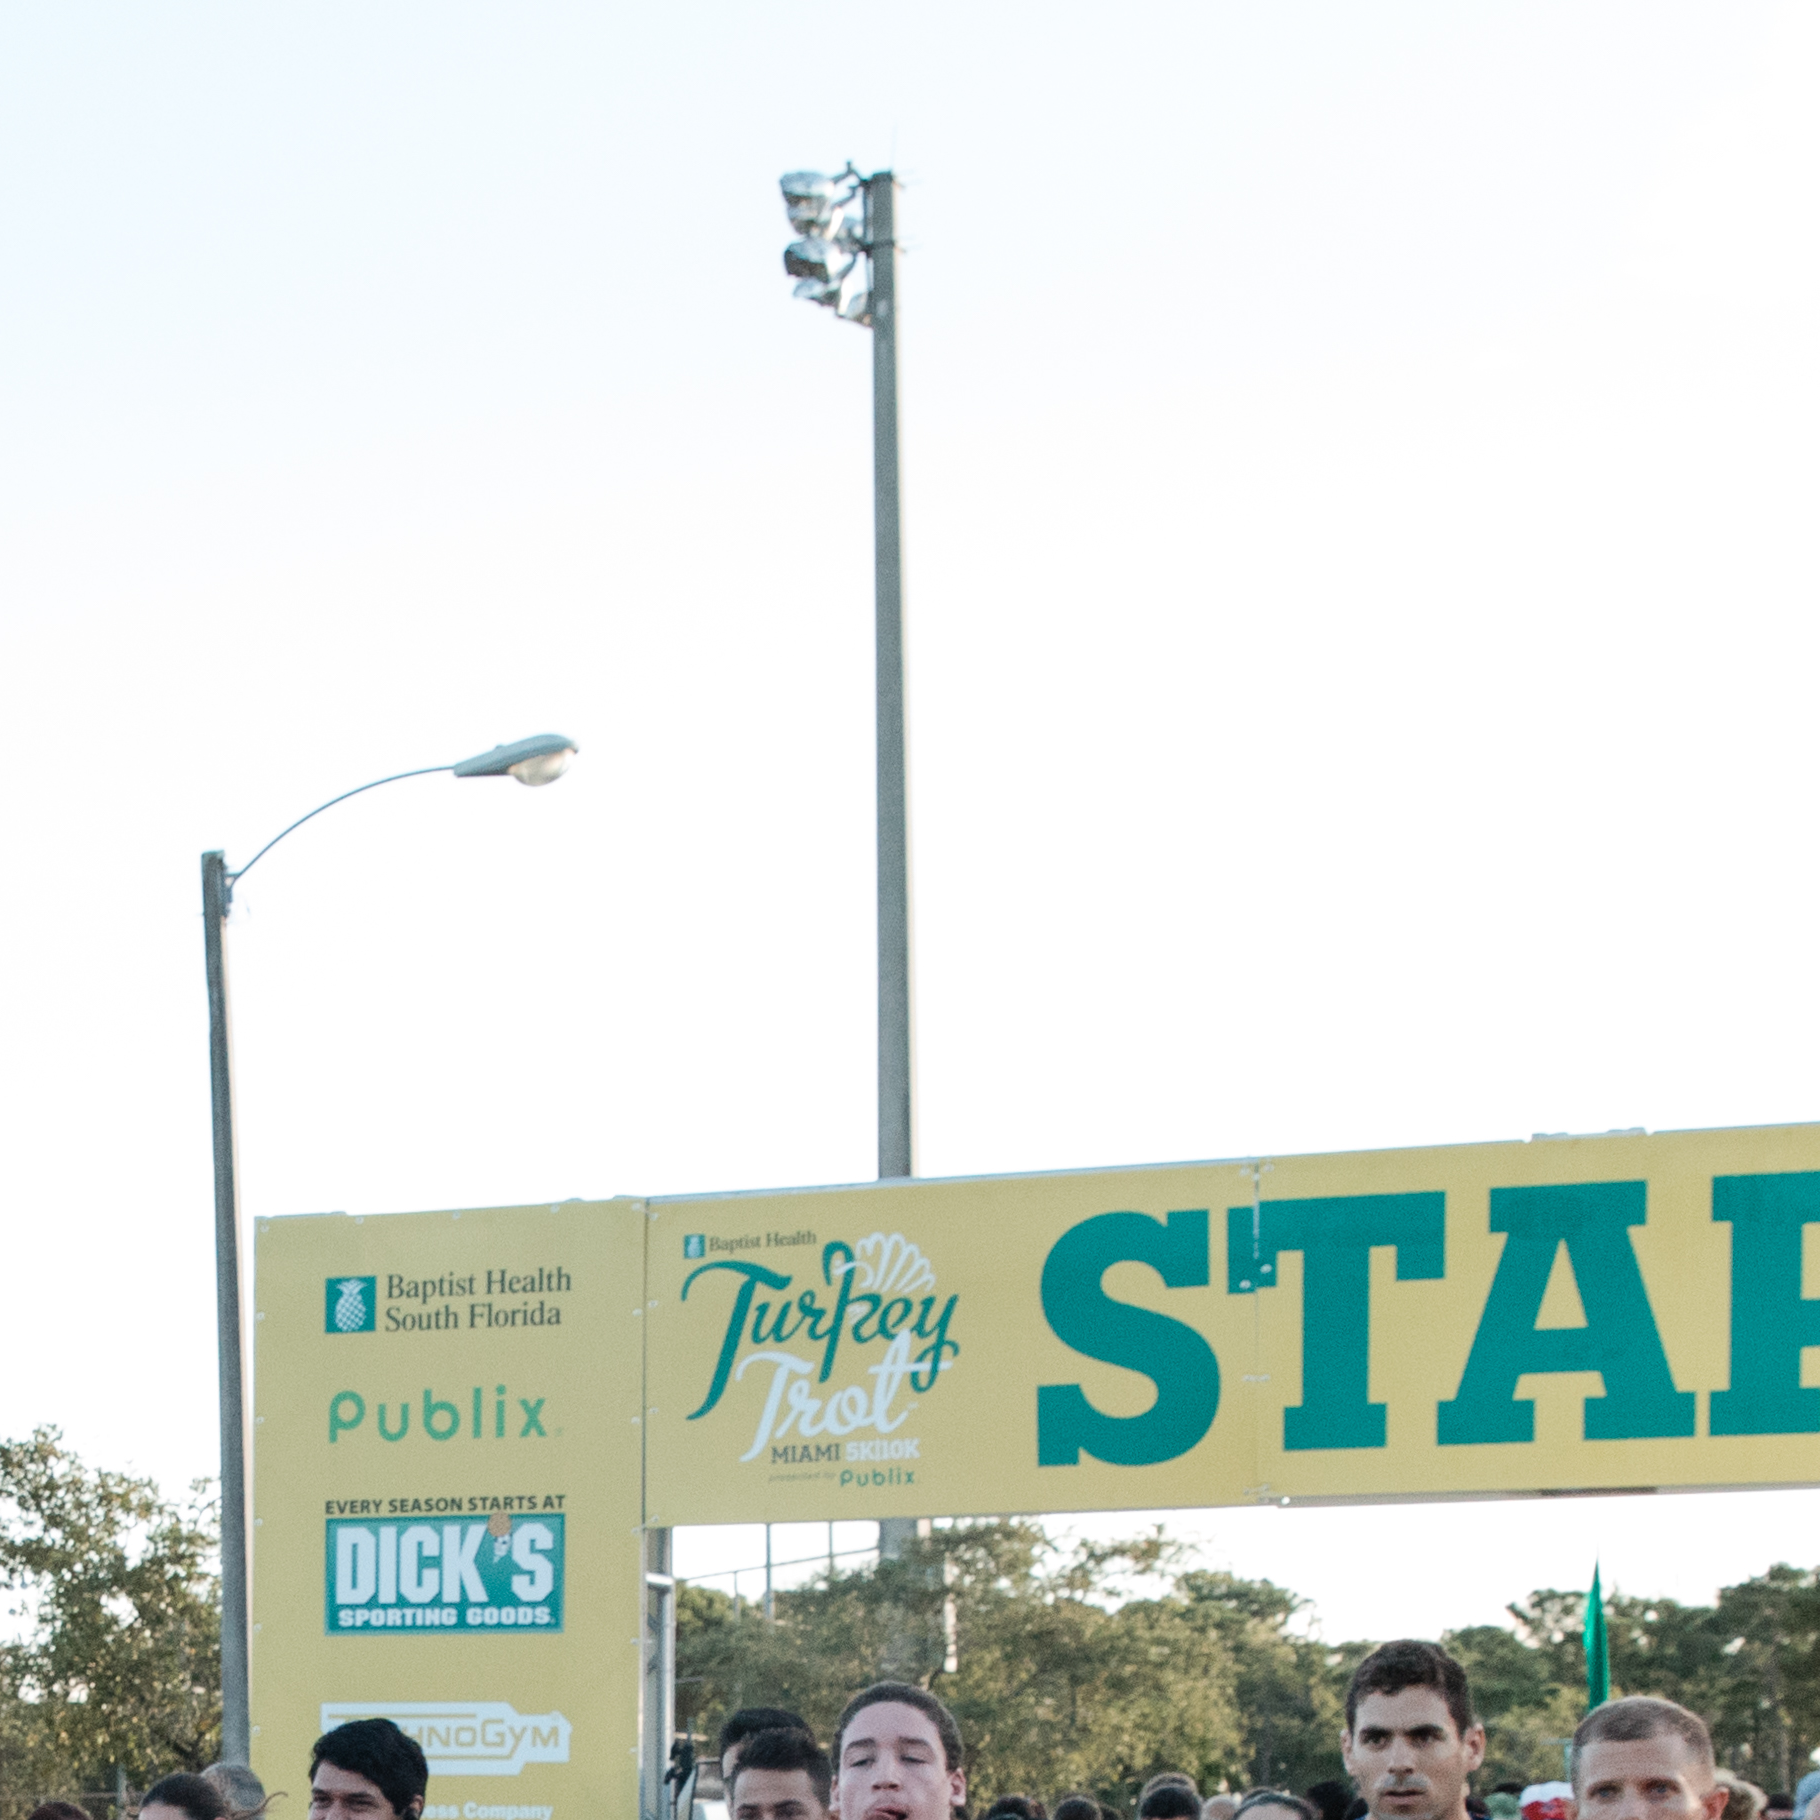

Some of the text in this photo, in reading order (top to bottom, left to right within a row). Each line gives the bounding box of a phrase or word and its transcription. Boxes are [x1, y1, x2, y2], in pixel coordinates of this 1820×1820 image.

[709, 1230, 817, 1253] Baptist Health
[385, 1265, 573, 1303] Baptist Health
[384, 1301, 562, 1333] South Florida
[681, 1241, 960, 1421] Turkey
[735, 1329, 953, 1463] Trot
[329, 1384, 550, 1443] Publix
[771, 1443, 841, 1464] MIAMI
[840, 1468, 915, 1488] Publix
[325, 1493, 566, 1515] EVERY SEASON STARTS AT
[338, 1606, 552, 1627] SPORTING GOODS
